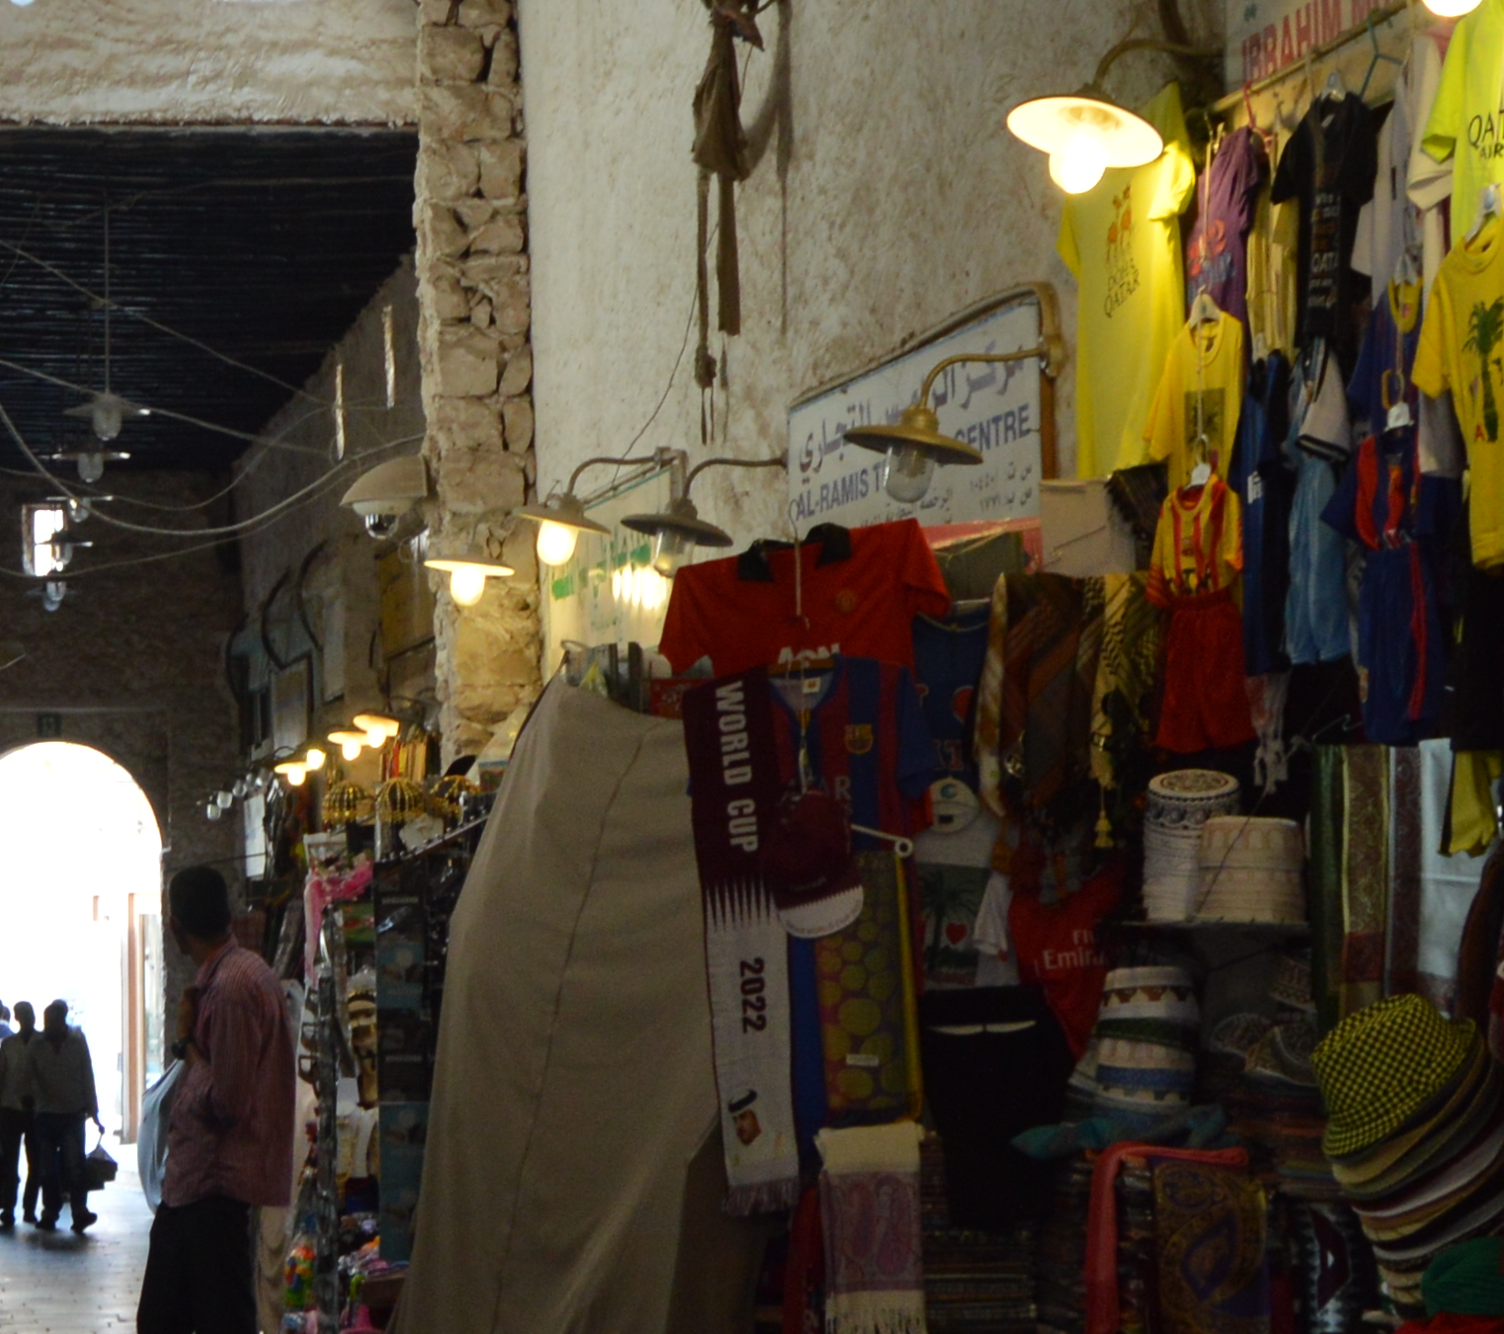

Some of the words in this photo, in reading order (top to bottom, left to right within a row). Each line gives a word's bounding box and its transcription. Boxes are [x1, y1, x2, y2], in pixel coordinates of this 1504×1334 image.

[795, 468, 870, 522] AL-RAMIS
[714, 679, 753, 787] WORLD
[727, 797, 760, 855] CUP
[740, 956, 767, 1036] 2022
